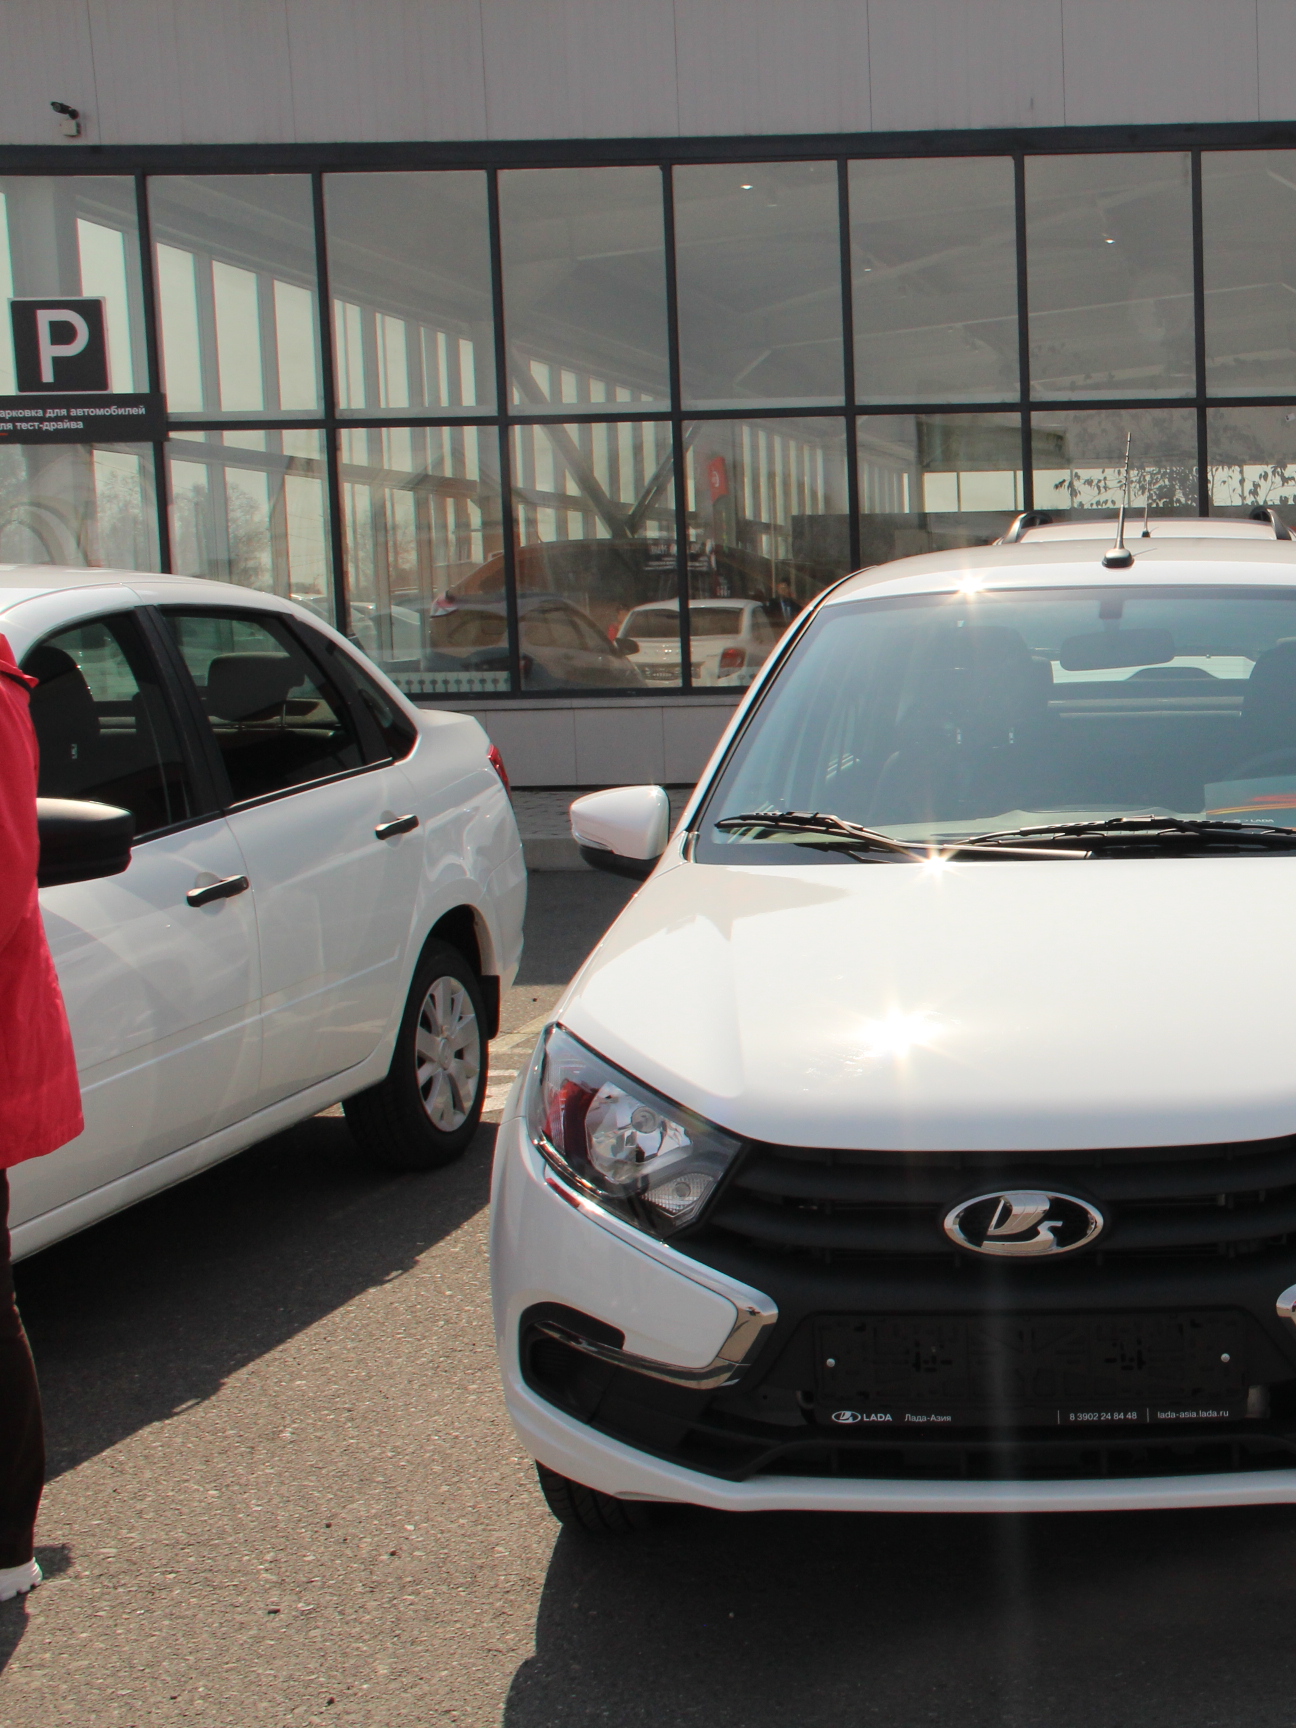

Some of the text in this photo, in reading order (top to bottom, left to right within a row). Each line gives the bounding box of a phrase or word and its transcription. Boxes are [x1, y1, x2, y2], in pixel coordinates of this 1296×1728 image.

[36, 309, 89, 382] P
[0, 405, 146, 420] арковка для автомобилей
[0, 420, 84, 431] ля тест-драйва
[863, 1413, 952, 1422] LADA Лада-Азия
[1069, 1411, 1137, 1421] 8 3902 24 84 48
[1157, 1410, 1229, 1418] lada-asia.lada.ru
